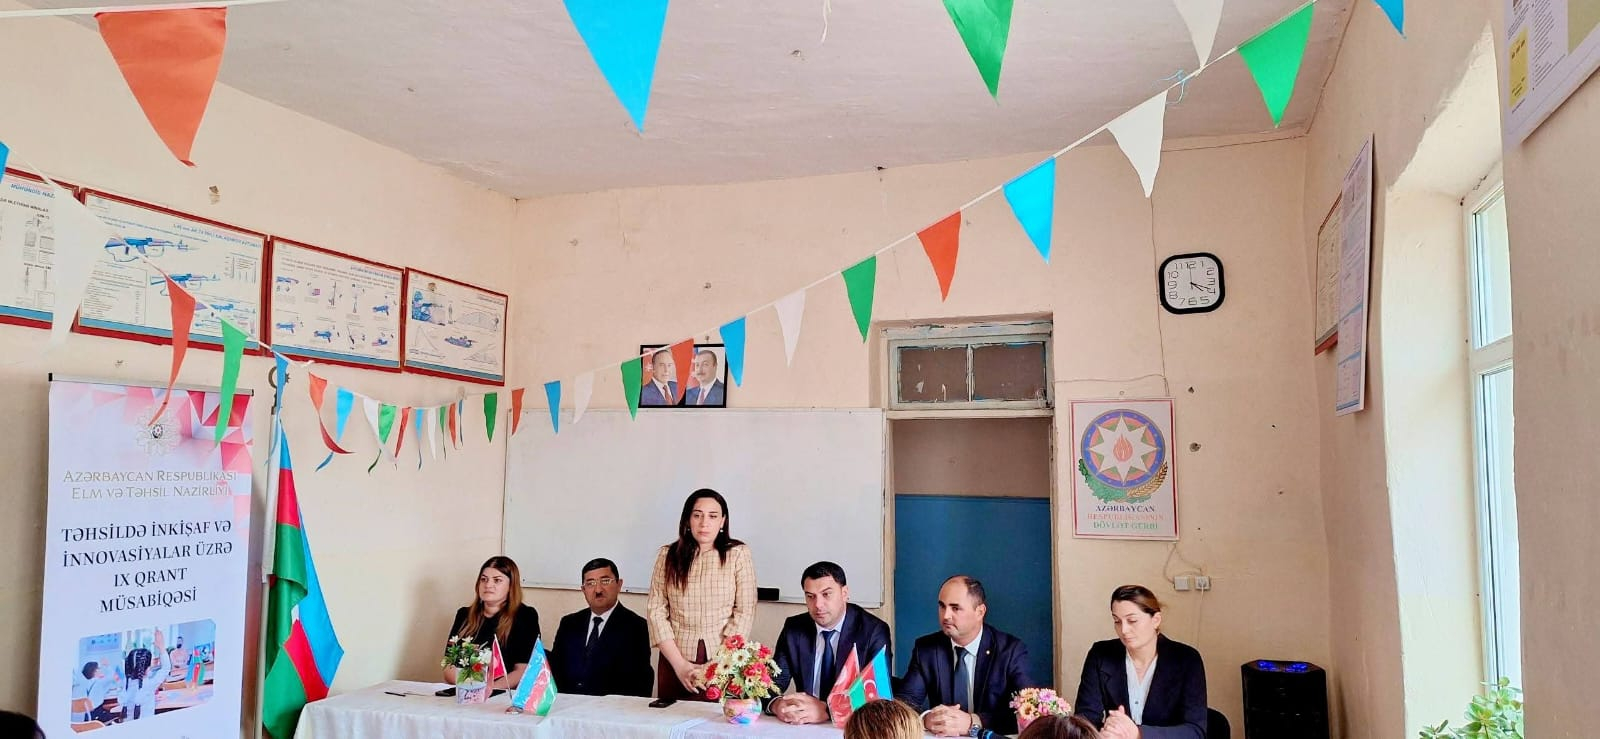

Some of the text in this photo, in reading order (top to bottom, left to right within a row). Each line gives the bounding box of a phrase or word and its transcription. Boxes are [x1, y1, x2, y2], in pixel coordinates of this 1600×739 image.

[1185, 260, 1197, 269] 12
[1168, 271, 1179, 279] 10
[1168, 281, 1177, 289] 9
[1188, 297, 1197, 305] 6
[63, 470, 153, 482] AZƏRBAYCAN
[72, 487, 103, 499] ELM
[61, 519, 231, 542] TƏHSİLDƏ İNKİŞAF VƏ
[63, 541, 233, 567] İNNOVASİYALAR ÜZRƏ
[114, 567, 188, 588] IX QRANT
[100, 586, 198, 613] MÜSABİQƏSİ
